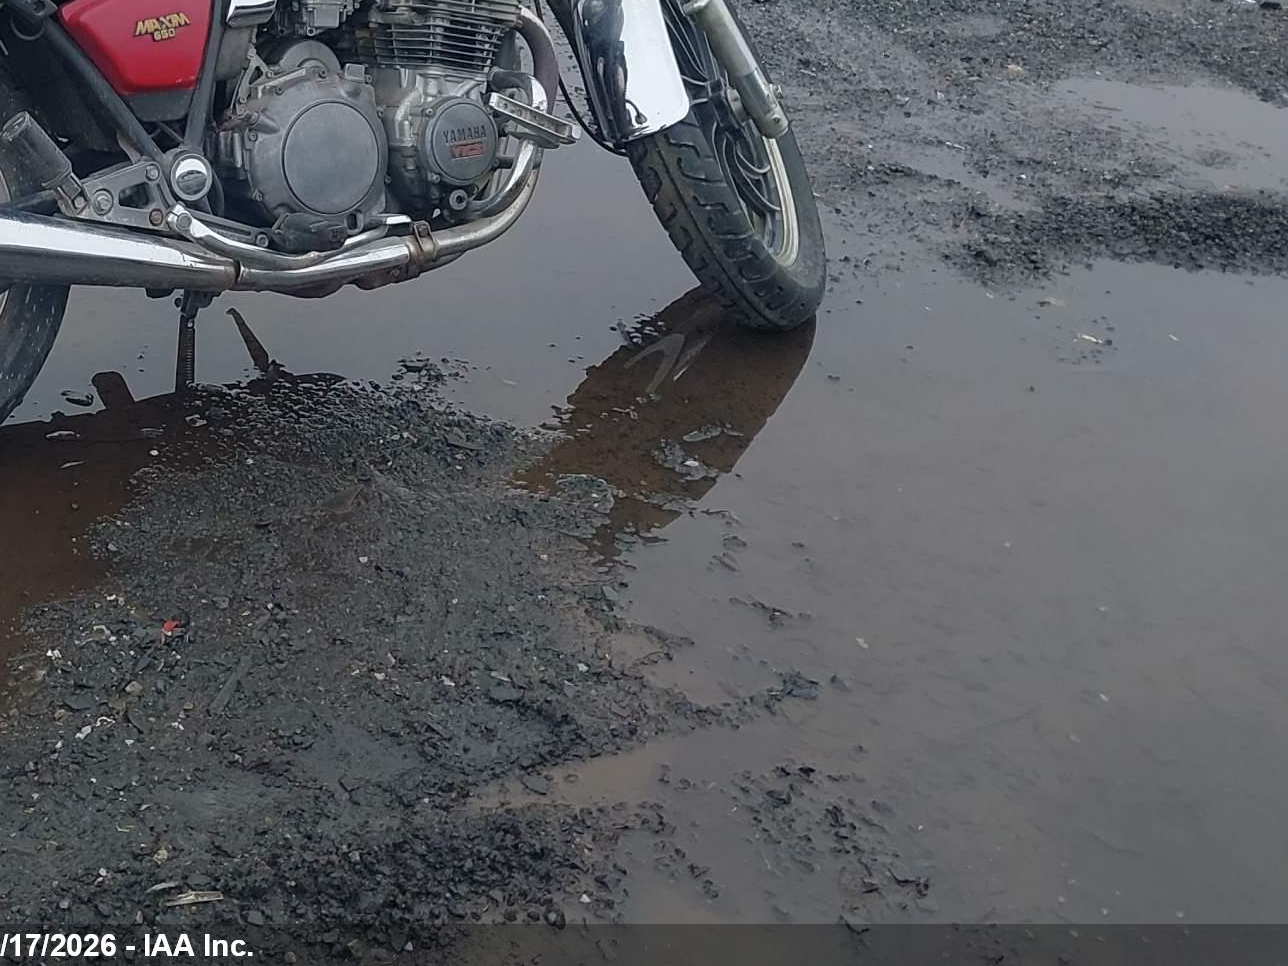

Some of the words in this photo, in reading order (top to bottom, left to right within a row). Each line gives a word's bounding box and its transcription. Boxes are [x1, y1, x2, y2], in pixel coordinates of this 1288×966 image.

[135, 12, 191, 36] MAXIM
[153, 27, 176, 41] 650
[442, 125, 487, 143] YAMAHA
